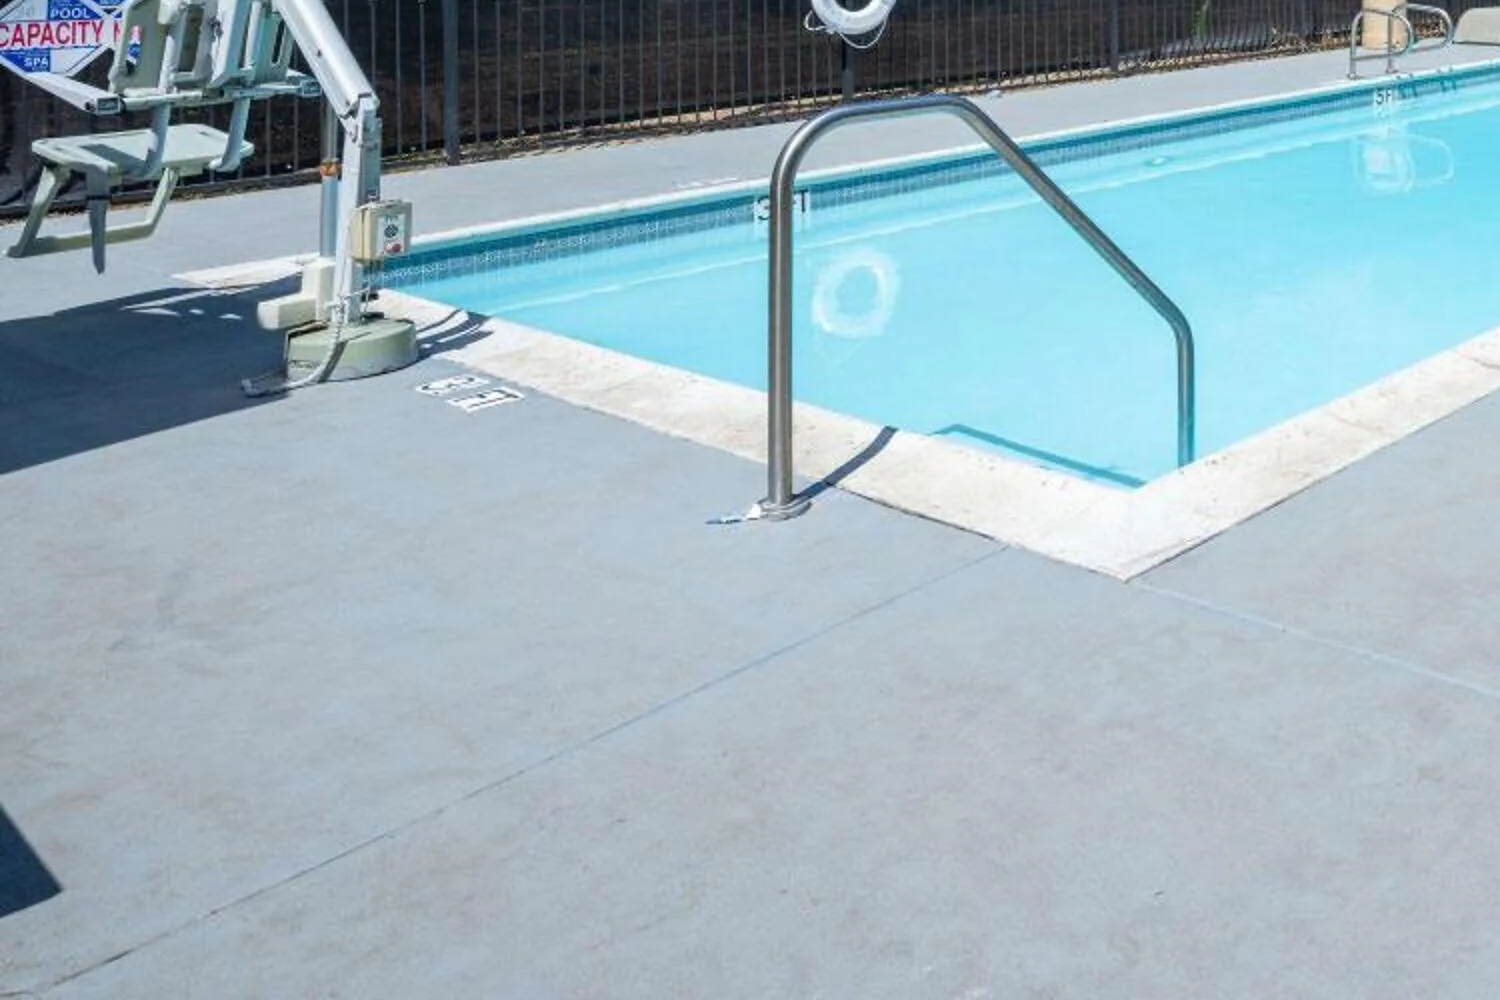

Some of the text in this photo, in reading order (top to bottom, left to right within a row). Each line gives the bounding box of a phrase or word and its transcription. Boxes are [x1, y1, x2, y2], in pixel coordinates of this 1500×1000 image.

[51, 7, 91, 19] POOL
[0, 20, 104, 47] CAPACITY
[24, 56, 49, 68] SPA
